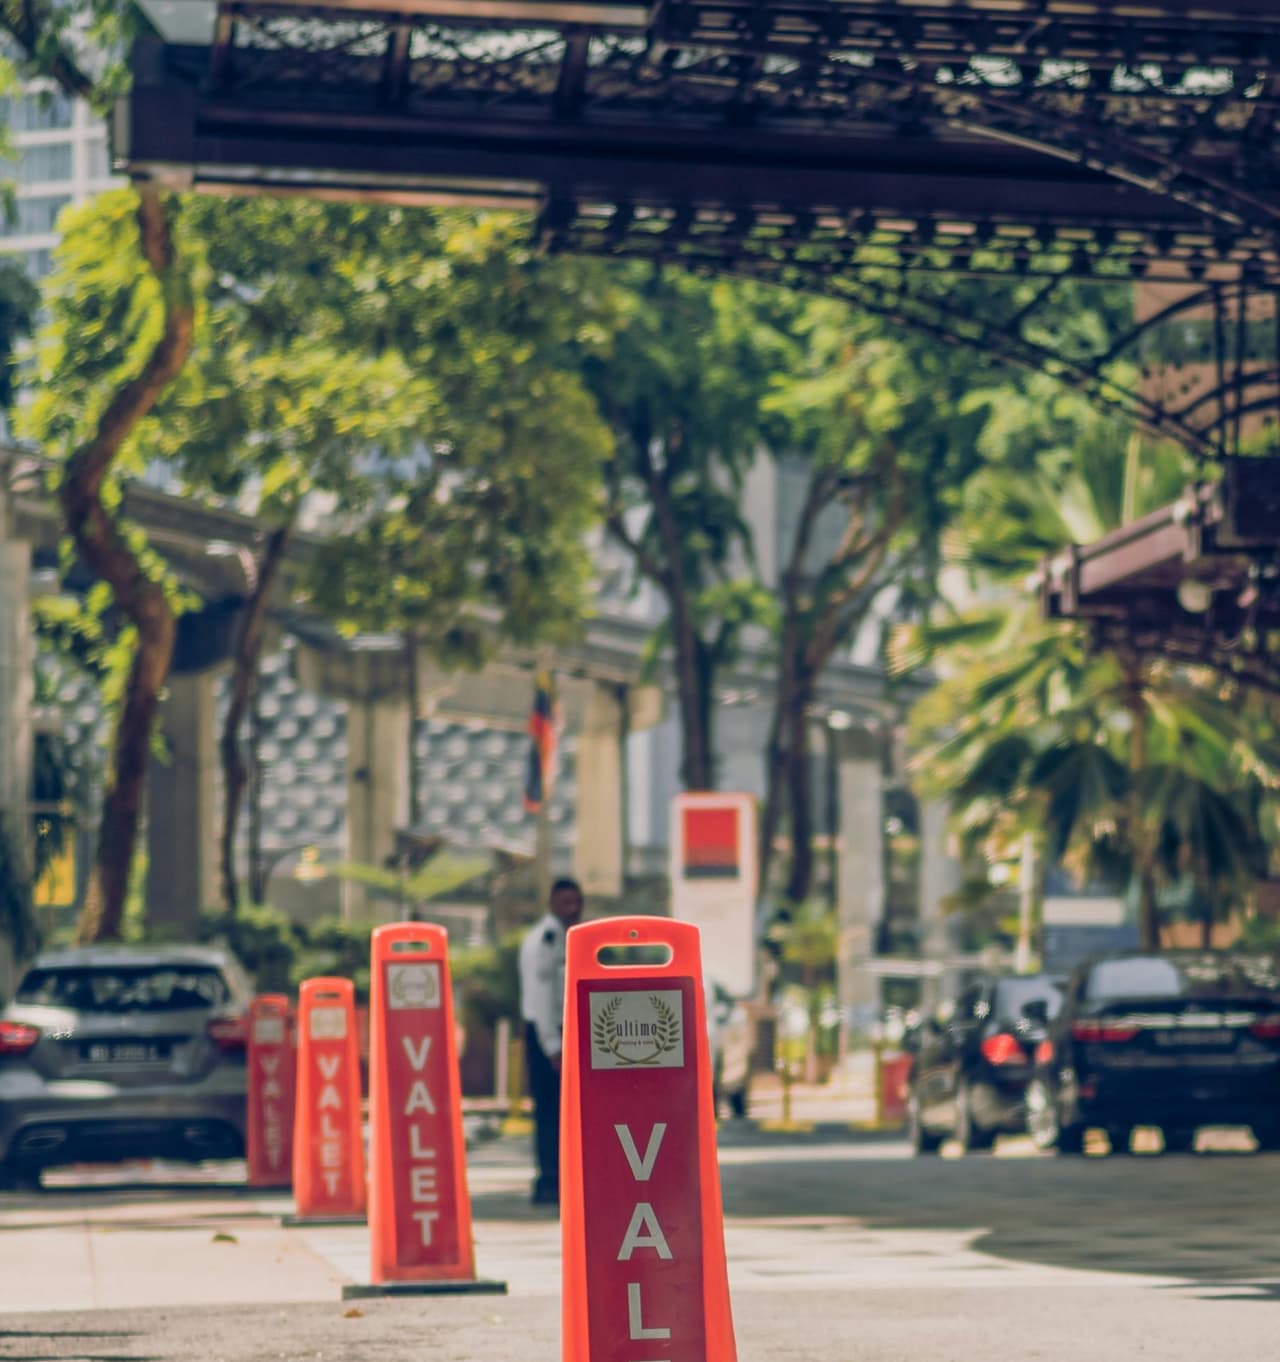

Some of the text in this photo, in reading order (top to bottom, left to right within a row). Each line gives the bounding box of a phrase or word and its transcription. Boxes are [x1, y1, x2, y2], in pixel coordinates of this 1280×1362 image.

[616, 1019, 657, 1037] ultimo
[260, 1055, 284, 1170] VALET
[318, 1055, 343, 1197] VALET
[402, 1036, 439, 1247] VALET
